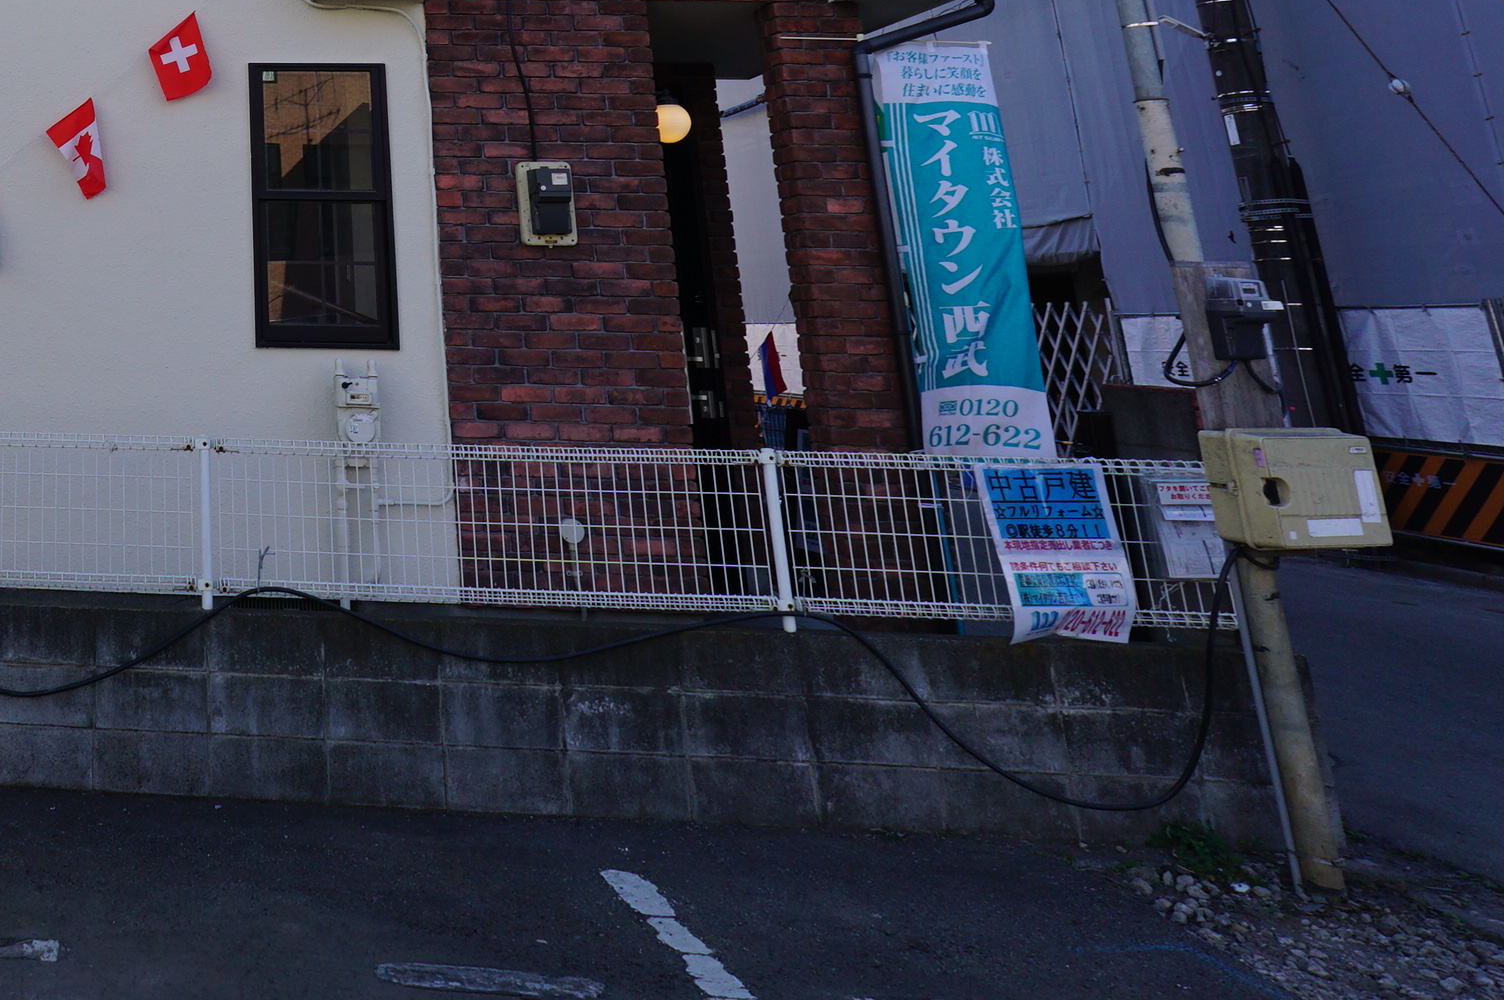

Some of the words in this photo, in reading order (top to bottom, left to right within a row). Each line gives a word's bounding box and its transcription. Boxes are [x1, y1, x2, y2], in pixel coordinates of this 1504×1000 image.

[901, 65, 982, 81] 暮らしに笑顔を
[902, 82, 987, 98] 住まいに感動を
[982, 145, 1018, 230] 株式会社
[912, 108, 992, 380] マイタウン西武
[958, 398, 1020, 418] 0120
[928, 424, 1043, 450] 612-622
[987, 470, 1097, 501] 中古戸建
